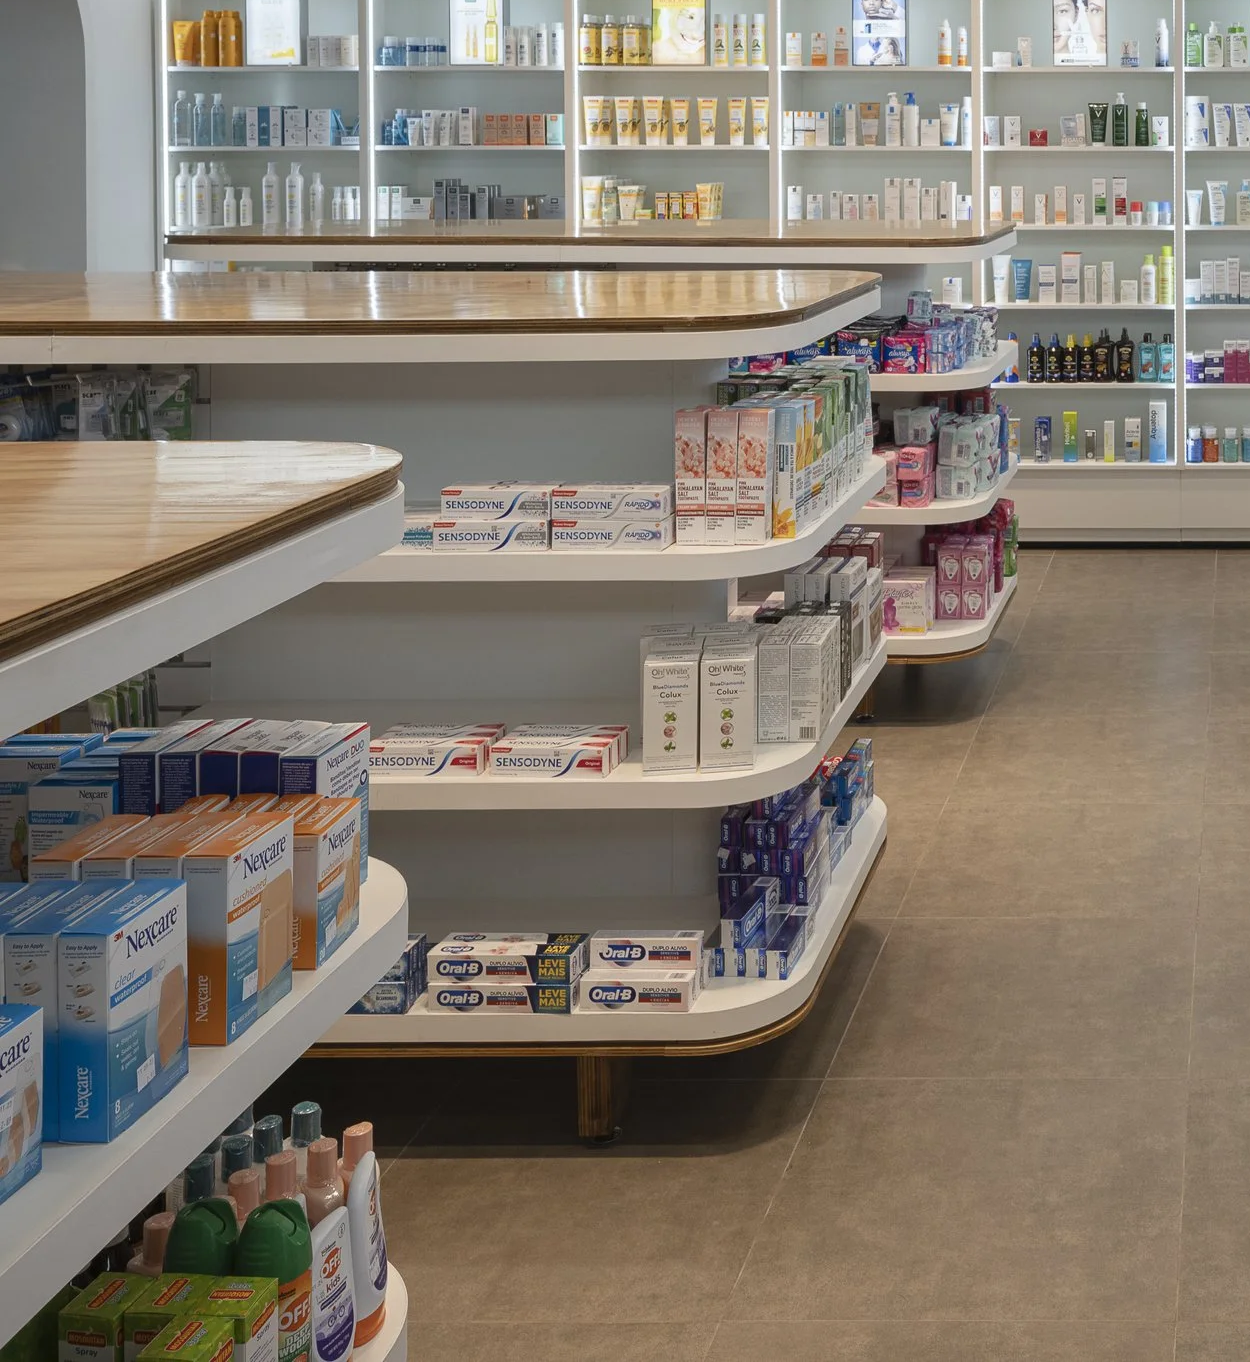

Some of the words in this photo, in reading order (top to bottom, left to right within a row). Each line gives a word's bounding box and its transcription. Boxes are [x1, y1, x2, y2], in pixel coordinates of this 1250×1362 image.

[846, 345, 873, 356] always
[888, 348, 911, 358] always
[1150, 410, 1158, 439] Aquatop
[445, 500, 505, 510] SENSODYNE
[554, 500, 613, 510] SENSODYNE
[438, 531, 501, 542] SENSODYNE
[554, 531, 613, 541] SENSODYNE
[651, 668, 666, 679] Oh!
[666, 667, 689, 676] White
[708, 665, 722, 676] Oh!
[723, 665, 745, 673] White
[659, 691, 683, 699] Colux
[716, 688, 739, 696] Colux
[326, 750, 350, 771] Nexcare
[350, 739, 365, 755] DUO
[27, 761, 56, 771] Nexcare
[369, 756, 436, 767] SENSODYNE
[496, 757, 562, 768] SENSODYNE
[79, 790, 108, 799] Nexcare
[328, 818, 356, 855] Nexcare
[232, 853, 242, 864] 3M
[242, 835, 287, 880] Nexcare
[232, 873, 268, 907] cushioned
[232, 895, 261, 919] waterproof
[113, 930, 124, 943] 3M
[126, 906, 178, 960] Nexcare
[30, 943, 44, 951] Apply
[604, 947, 642, 959] Oral-B
[439, 961, 480, 975] Oral-B
[538, 958, 566, 968] LEVE
[538, 967, 566, 977] MAIS
[114, 967, 136, 990] clear
[114, 973, 149, 1004] waterproof
[195, 975, 212, 1023] Nexcare
[439, 991, 480, 1005] Oral-B
[539, 989, 567, 999] LEVE
[592, 989, 632, 1001] Oral-B
[539, 997, 567, 1007] MAIS
[75, 1065, 92, 1119] Nexcare
[321, 1254, 342, 1279] OFF!
[326, 1273, 342, 1294] kids
[279, 1293, 312, 1331] OFF!
[284, 1323, 311, 1347] DEEP
[75, 1347, 98, 1357] Spray
